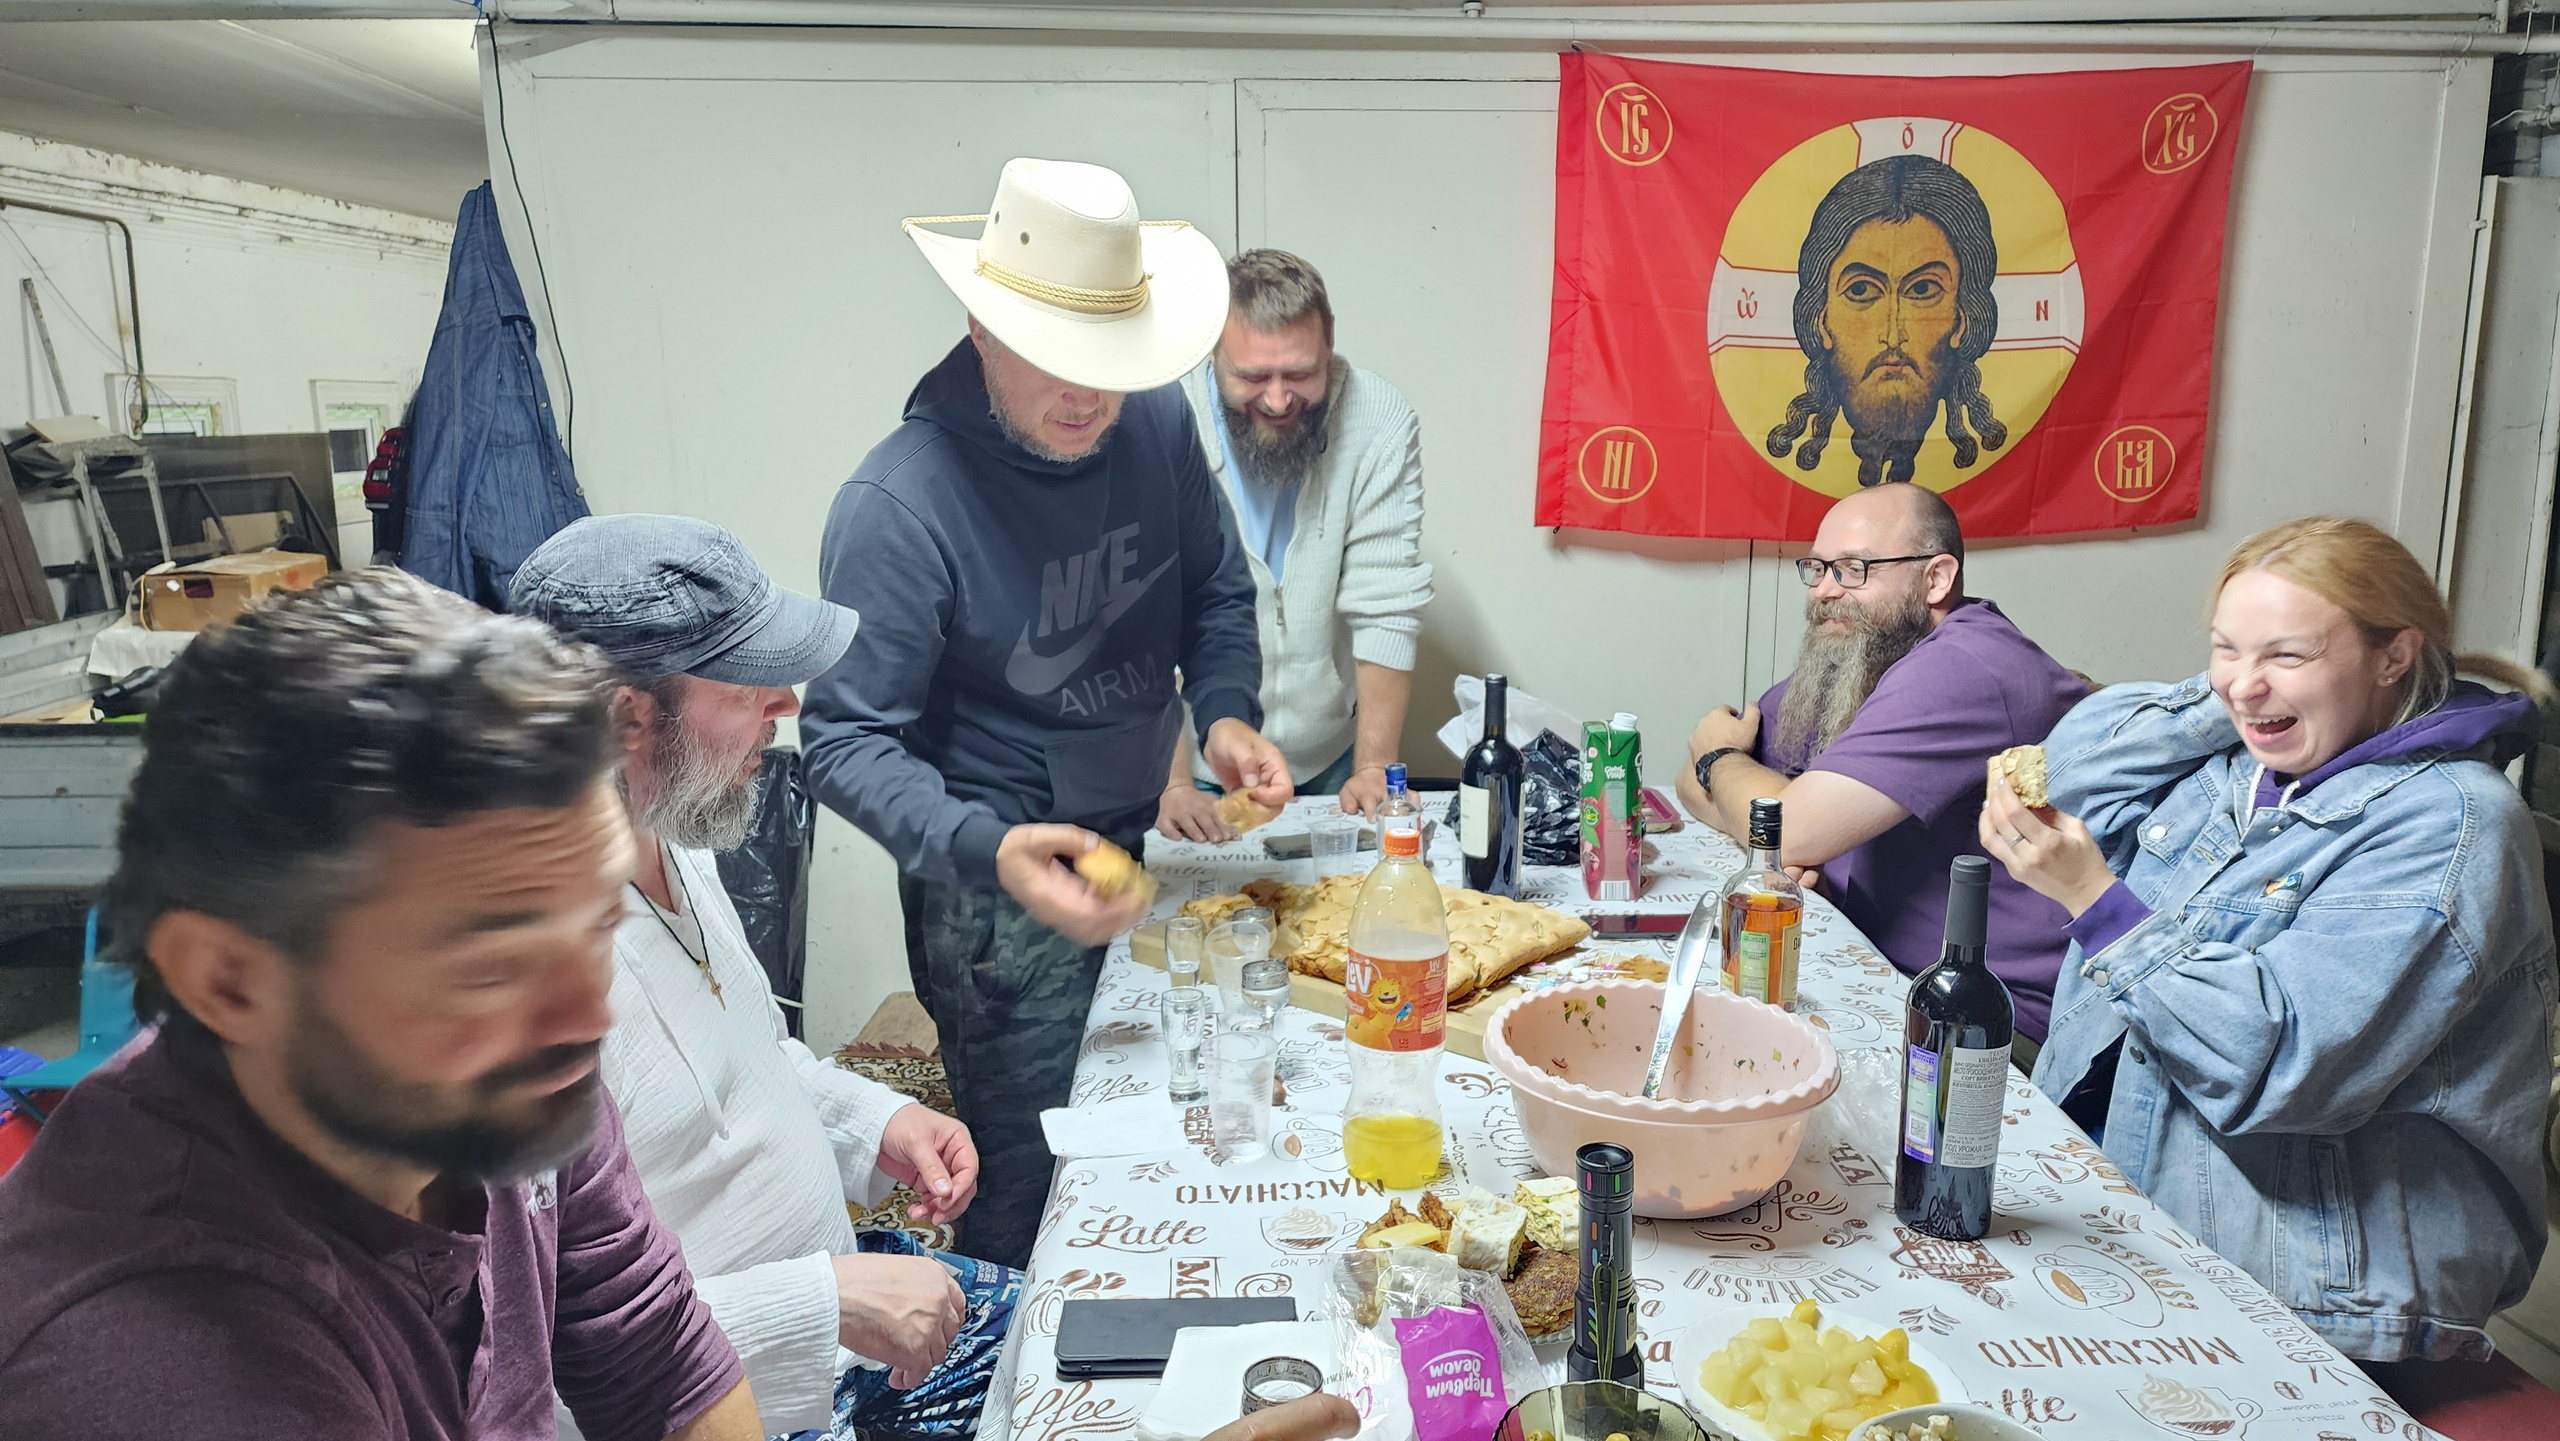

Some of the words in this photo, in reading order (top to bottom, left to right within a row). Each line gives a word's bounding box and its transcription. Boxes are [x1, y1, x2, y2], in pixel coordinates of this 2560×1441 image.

[1037, 521, 1140, 637] NIKE
[1176, 1177, 1386, 1205] MACCHIATO
[1066, 1214, 1208, 1250] Latte
[1911, 1245, 1995, 1267] COFFEE
[1683, 1267, 1882, 1305] ESPRESSO
[2084, 1236, 2199, 1311] ESPRESSO
[2180, 1253, 2334, 1362] BREAKFAST
[1430, 1358, 1481, 1378] делом
[1978, 1336, 2246, 1367] MACCHIATO
[1426, 1375, 1495, 1399] Первым
